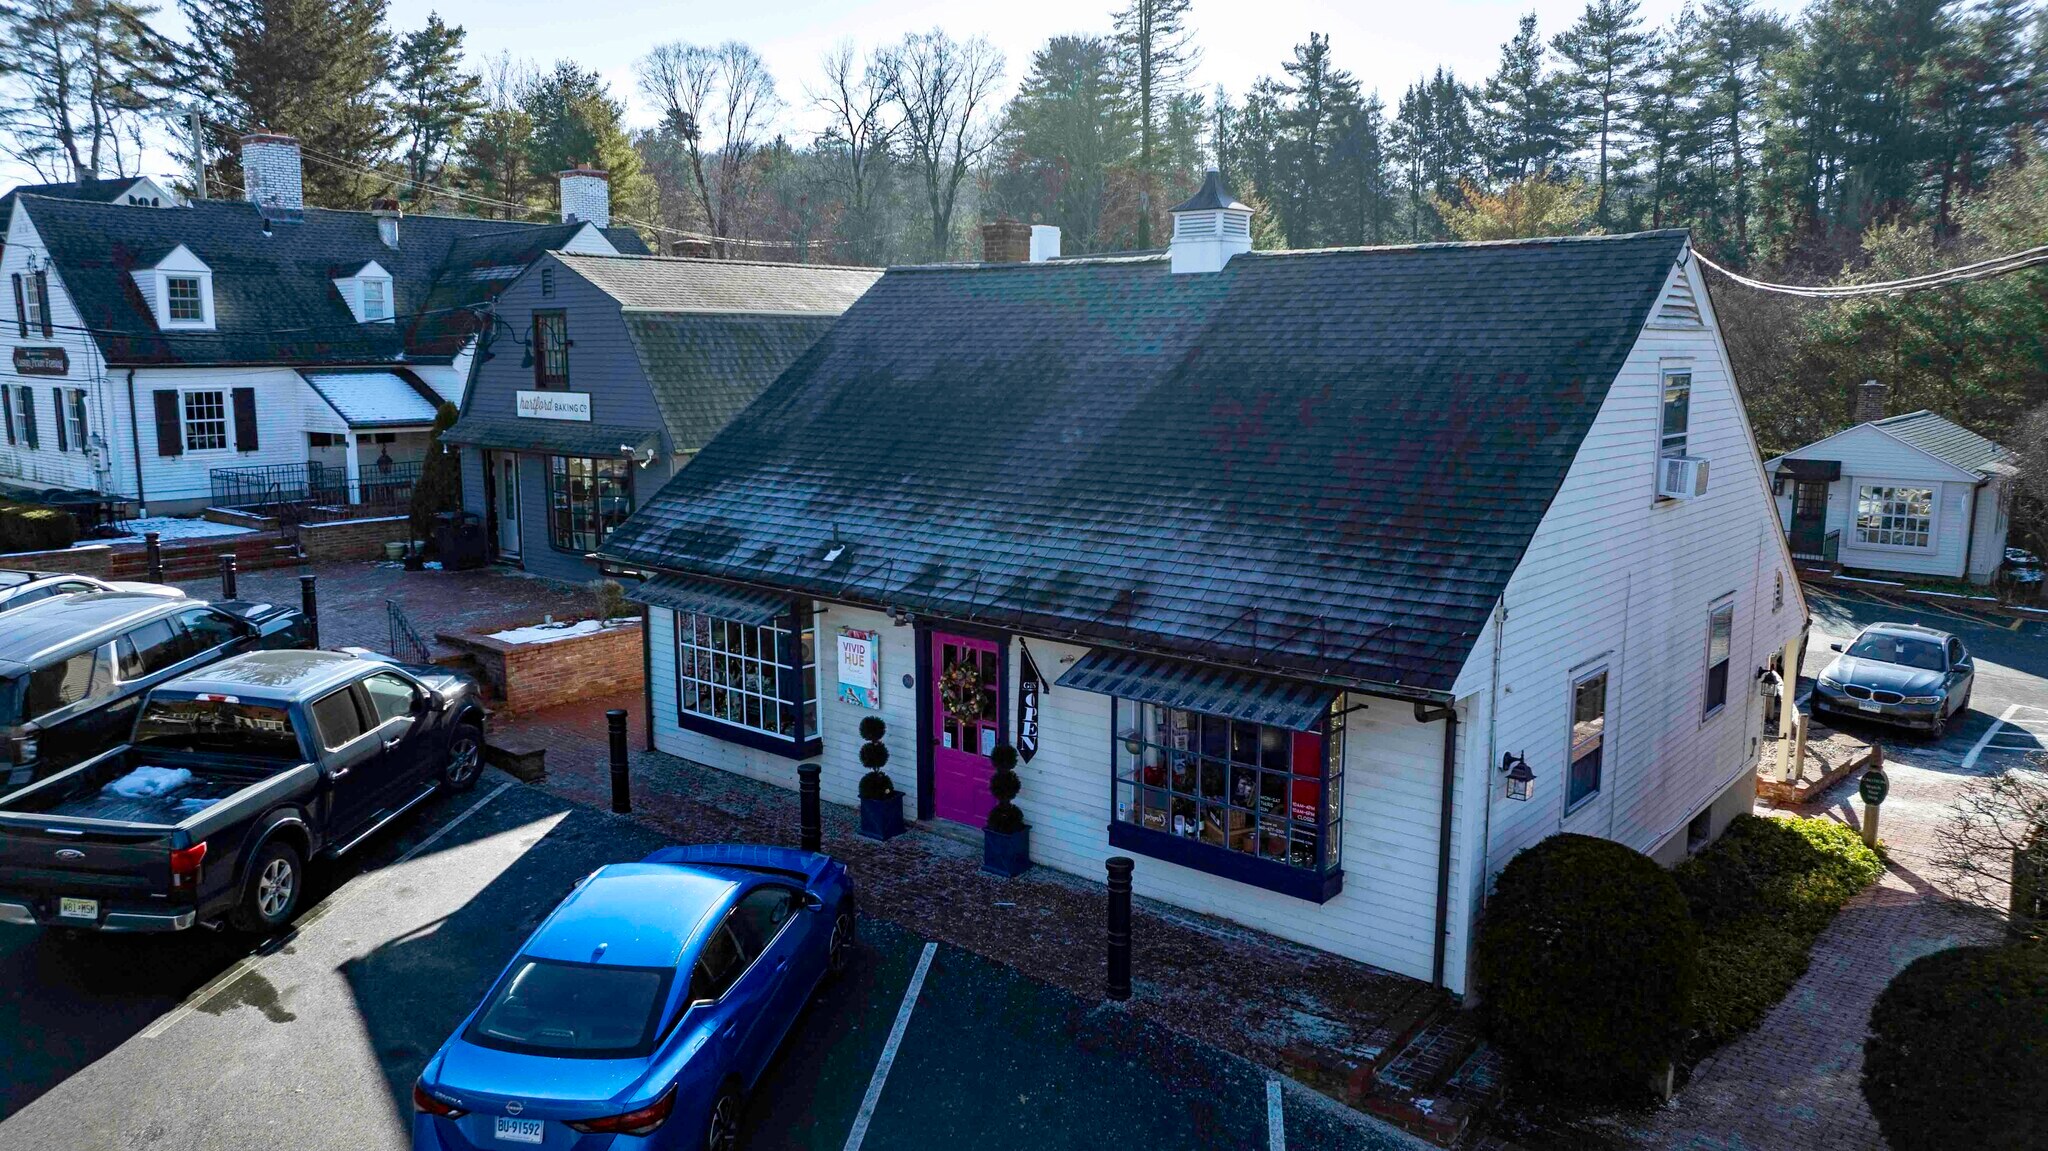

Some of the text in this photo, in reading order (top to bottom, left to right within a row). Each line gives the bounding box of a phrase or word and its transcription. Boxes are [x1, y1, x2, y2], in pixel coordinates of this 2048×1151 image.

[520, 396, 553, 415] hartford
[554, 403, 579, 412] BAKING
[843, 641, 865, 655] VIVID
[845, 652, 865, 667] HUE
[1020, 692, 1038, 751] OPEN
[1297, 815, 1316, 823] CLOSED
